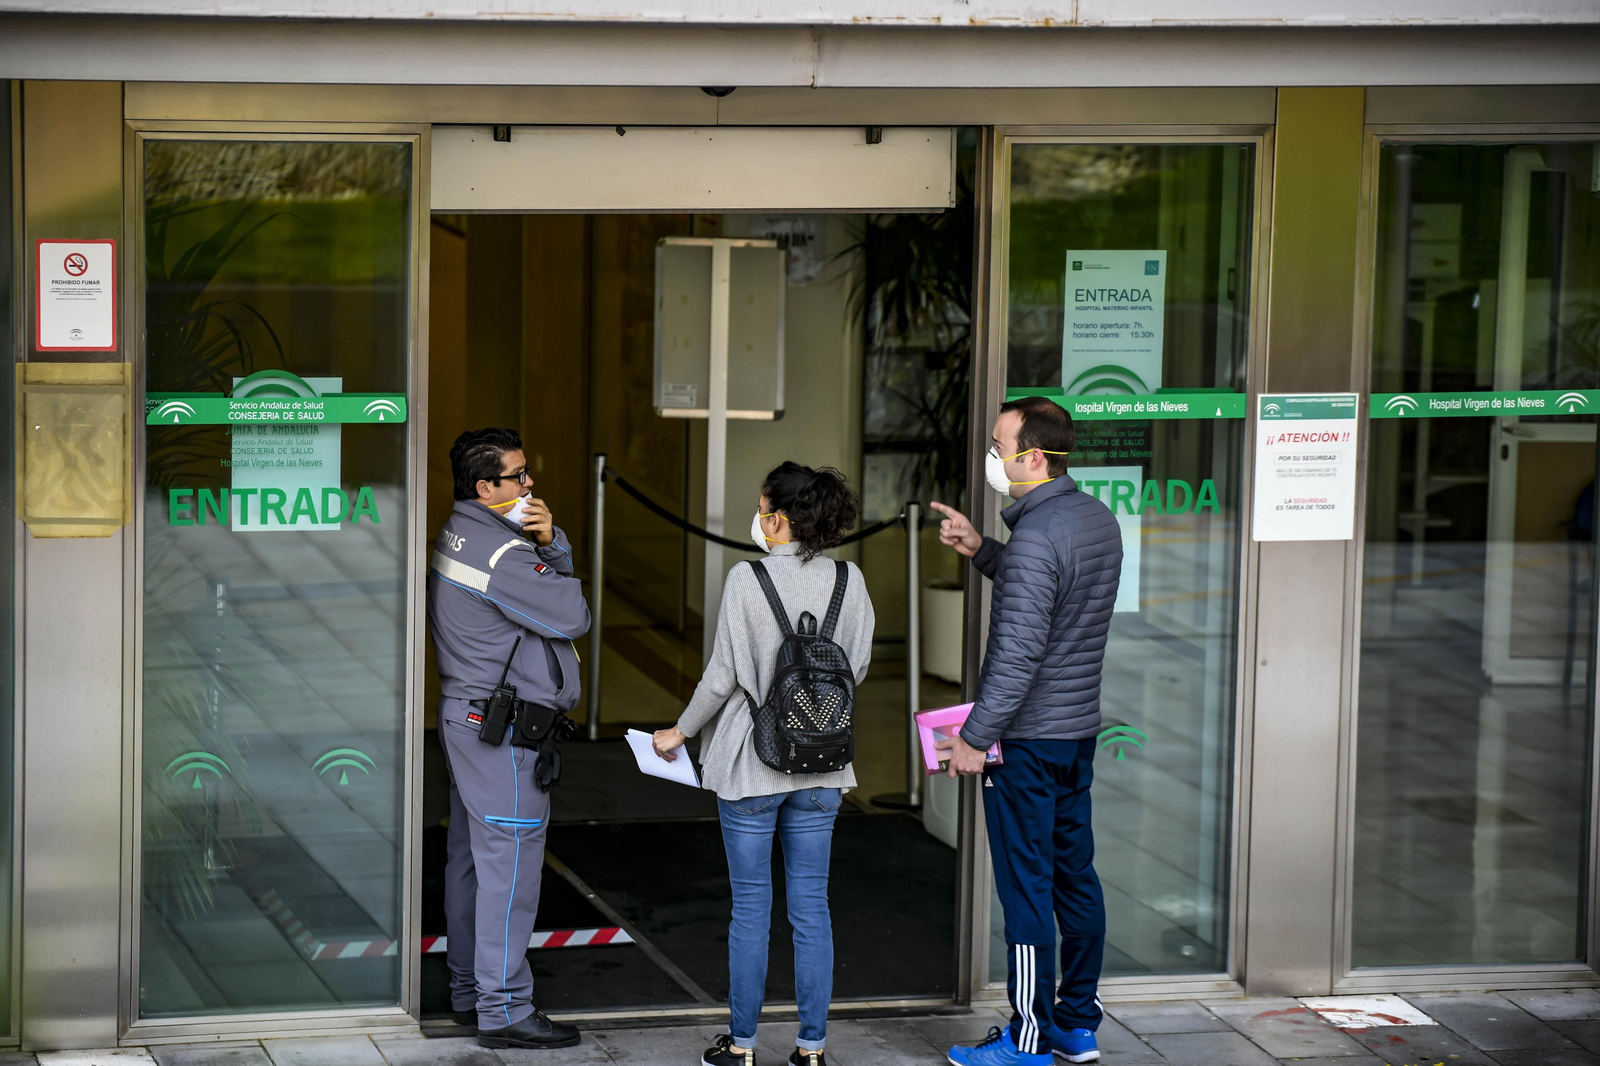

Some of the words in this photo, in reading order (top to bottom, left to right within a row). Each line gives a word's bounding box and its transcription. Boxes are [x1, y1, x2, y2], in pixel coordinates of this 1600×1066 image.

[1074, 288, 1152, 302] ENTRADA
[230, 401, 258, 409] Servicio
[260, 401, 290, 409] Andaluz
[303, 401, 324, 409] Salud
[1105, 401, 1132, 415] Virgen
[1134, 401, 1144, 412] de
[1146, 401, 1158, 412] las
[1160, 401, 1188, 412] Nieves
[1429, 398, 1462, 412] Hospital
[1464, 398, 1489, 412] Virgen
[1491, 398, 1501, 409] de
[1503, 398, 1515, 408] las
[1517, 397, 1545, 408] Nieves
[228, 412, 280, 420] CONSEJERIA
[283, 412, 294, 420] DE
[298, 411, 324, 420] SALUD
[225, 425, 252, 435] JUNTA
[257, 425, 268, 435] DE
[1278, 430, 1339, 442] ATENCIÓN
[1342, 432, 1350, 442] !!
[1068, 450, 1086, 459] spital
[1087, 450, 1108, 460] Virgen
[1109, 450, 1117, 458] de
[1119, 450, 1128, 458] las
[1130, 449, 1152, 457] Nieves
[220, 459, 249, 469] Hospital
[251, 459, 274, 469] Virgen
[276, 459, 285, 467] de
[286, 458, 297, 467] las
[299, 458, 323, 467] Nieves
[1075, 479, 1221, 515] TRADA
[168, 486, 381, 526] ENTRADA
